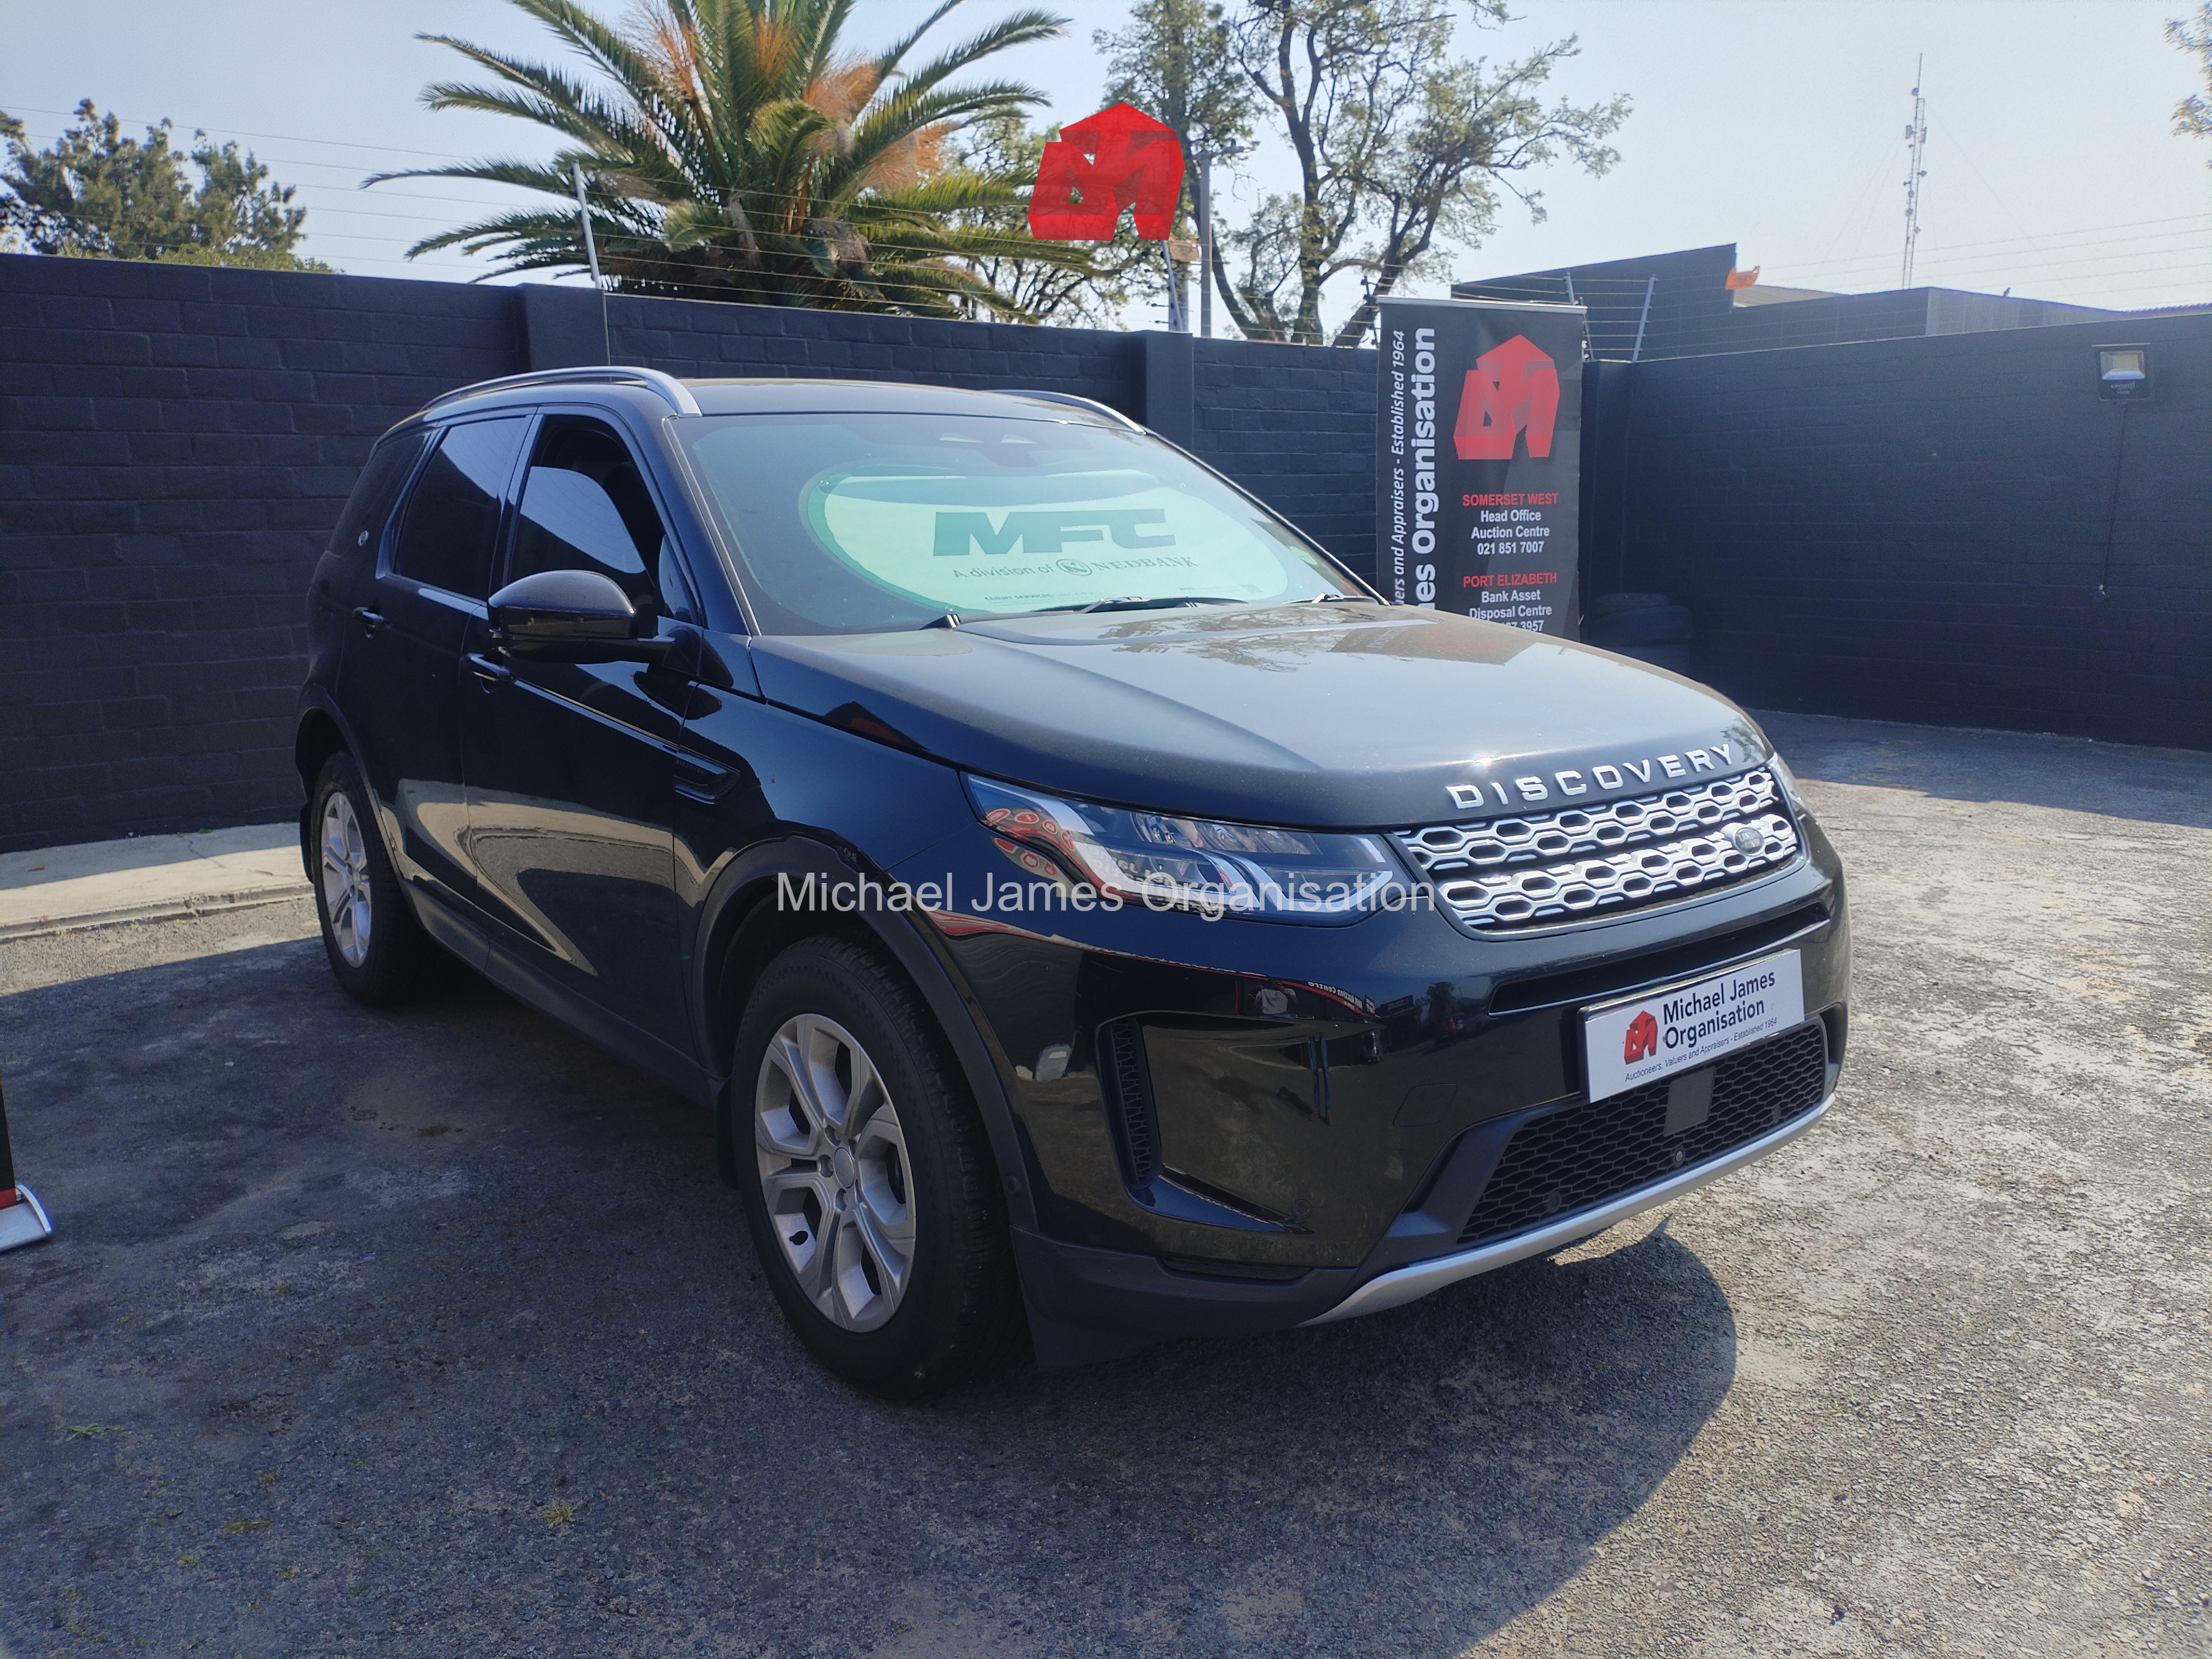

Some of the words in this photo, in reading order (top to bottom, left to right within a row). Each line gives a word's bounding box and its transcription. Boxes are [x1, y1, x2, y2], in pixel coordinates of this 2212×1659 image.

[1392, 330, 1405, 368] 1964
[1390, 371, 1405, 456] Established
[1411, 327, 1439, 554] Organisation
[1391, 468, 1406, 542] Appraisers
[1462, 493, 1524, 507] SOMERSET
[1528, 493, 1559, 505] WEST
[1481, 510, 1507, 522] Head
[1510, 509, 1541, 521] Office
[933, 509, 1176, 556] MFC
[1471, 527, 1513, 539] Auction
[1515, 525, 1550, 537] Centre
[1477, 543, 1495, 555] 021
[1498, 542, 1518, 554] 851
[1520, 541, 1544, 554] 7007
[953, 569, 968, 578] A
[970, 564, 1034, 577] division
[1037, 564, 1054, 575] of
[1095, 556, 1199, 569] NEDBANK
[1391, 544, 1405, 575] and
[1464, 575, 1494, 588] PORT
[1497, 572, 1557, 586] ELIZABETH
[1481, 590, 1509, 603] Bank
[1510, 589, 1541, 601] Asset
[1469, 606, 1515, 621] Disposal
[1518, 605, 1552, 617] Centre
[1446, 744, 1733, 810] DISCOVERY
[1663, 982, 1726, 1025] Michael
[1729, 971, 1776, 1001] James
[1665, 999, 1765, 1049] Organisation
[1624, 1062, 1663, 1082] Auctioneers,
[1664, 1053, 1687, 1067] Valuers
[1689, 1047, 1700, 1060] and
[1700, 1035, 1730, 1056] Appraisers
[1734, 1024, 1764, 1042] Established
[1764, 1016, 1777, 1030] 1964
